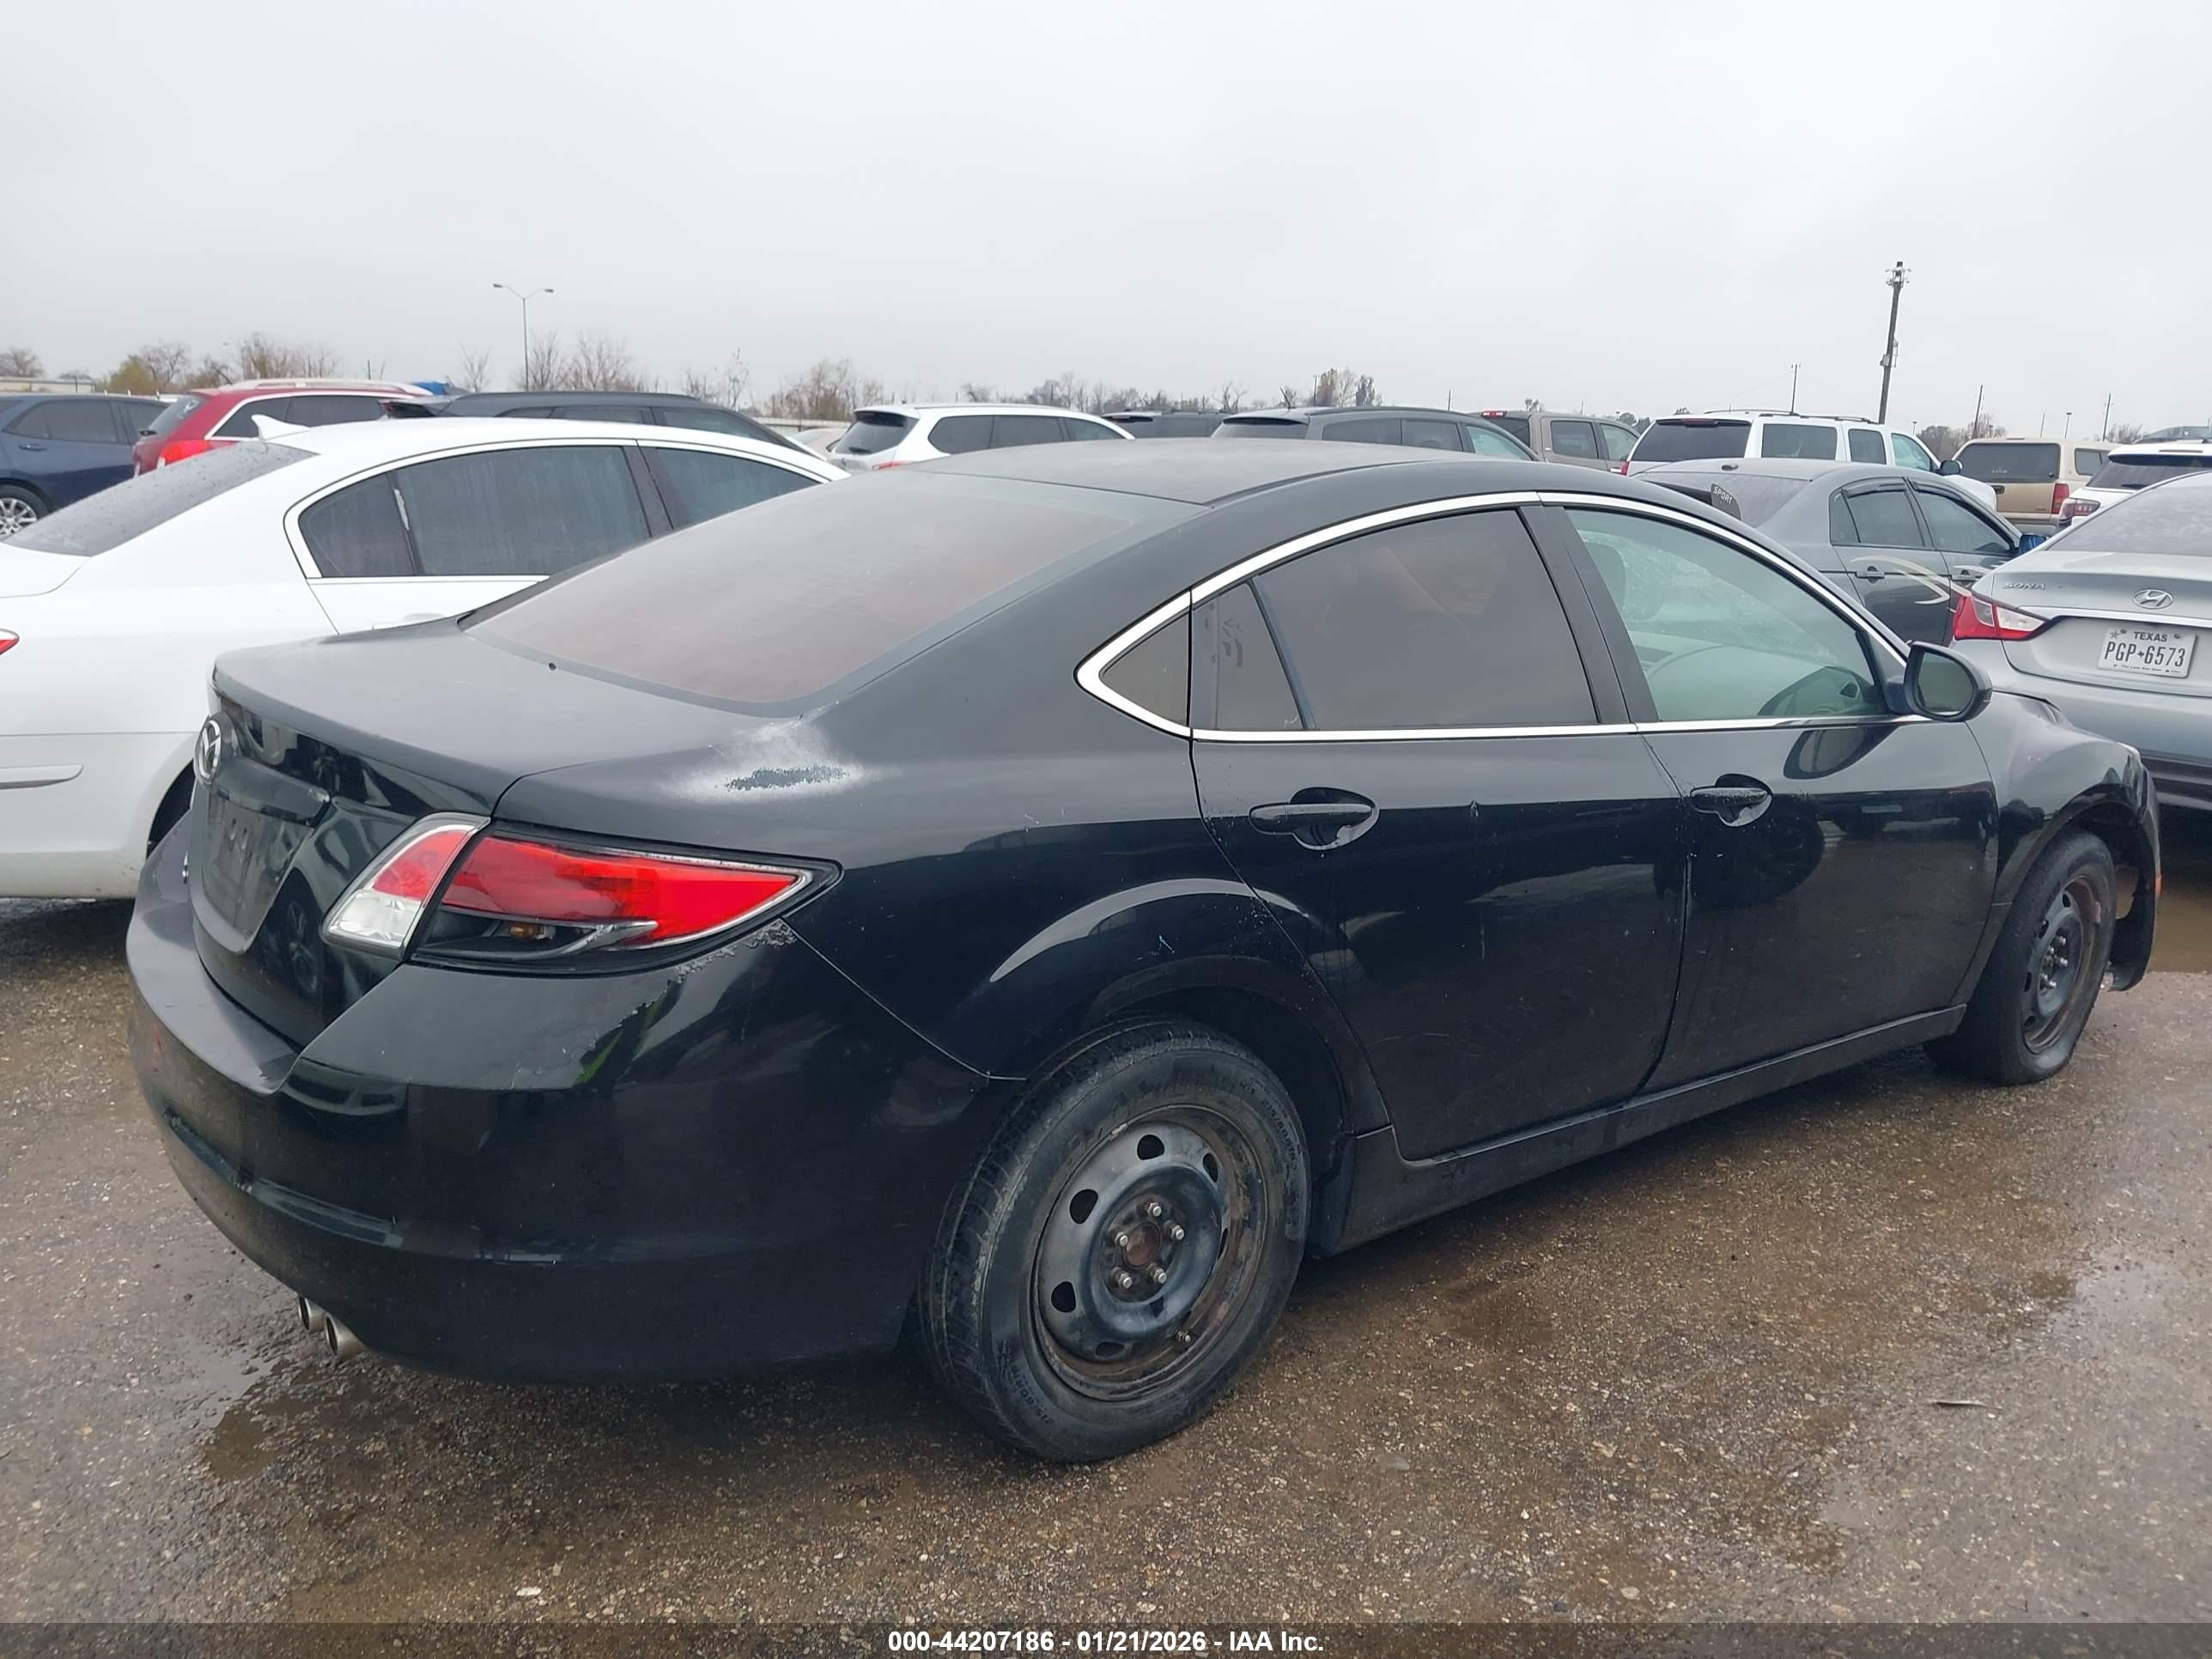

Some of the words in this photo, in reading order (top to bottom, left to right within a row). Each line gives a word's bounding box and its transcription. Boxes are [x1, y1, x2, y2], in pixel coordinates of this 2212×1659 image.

[1713, 486, 1733, 505] SPORT
[2002, 582, 2047, 591] SONA
[2133, 631, 2168, 642] TEXAS
